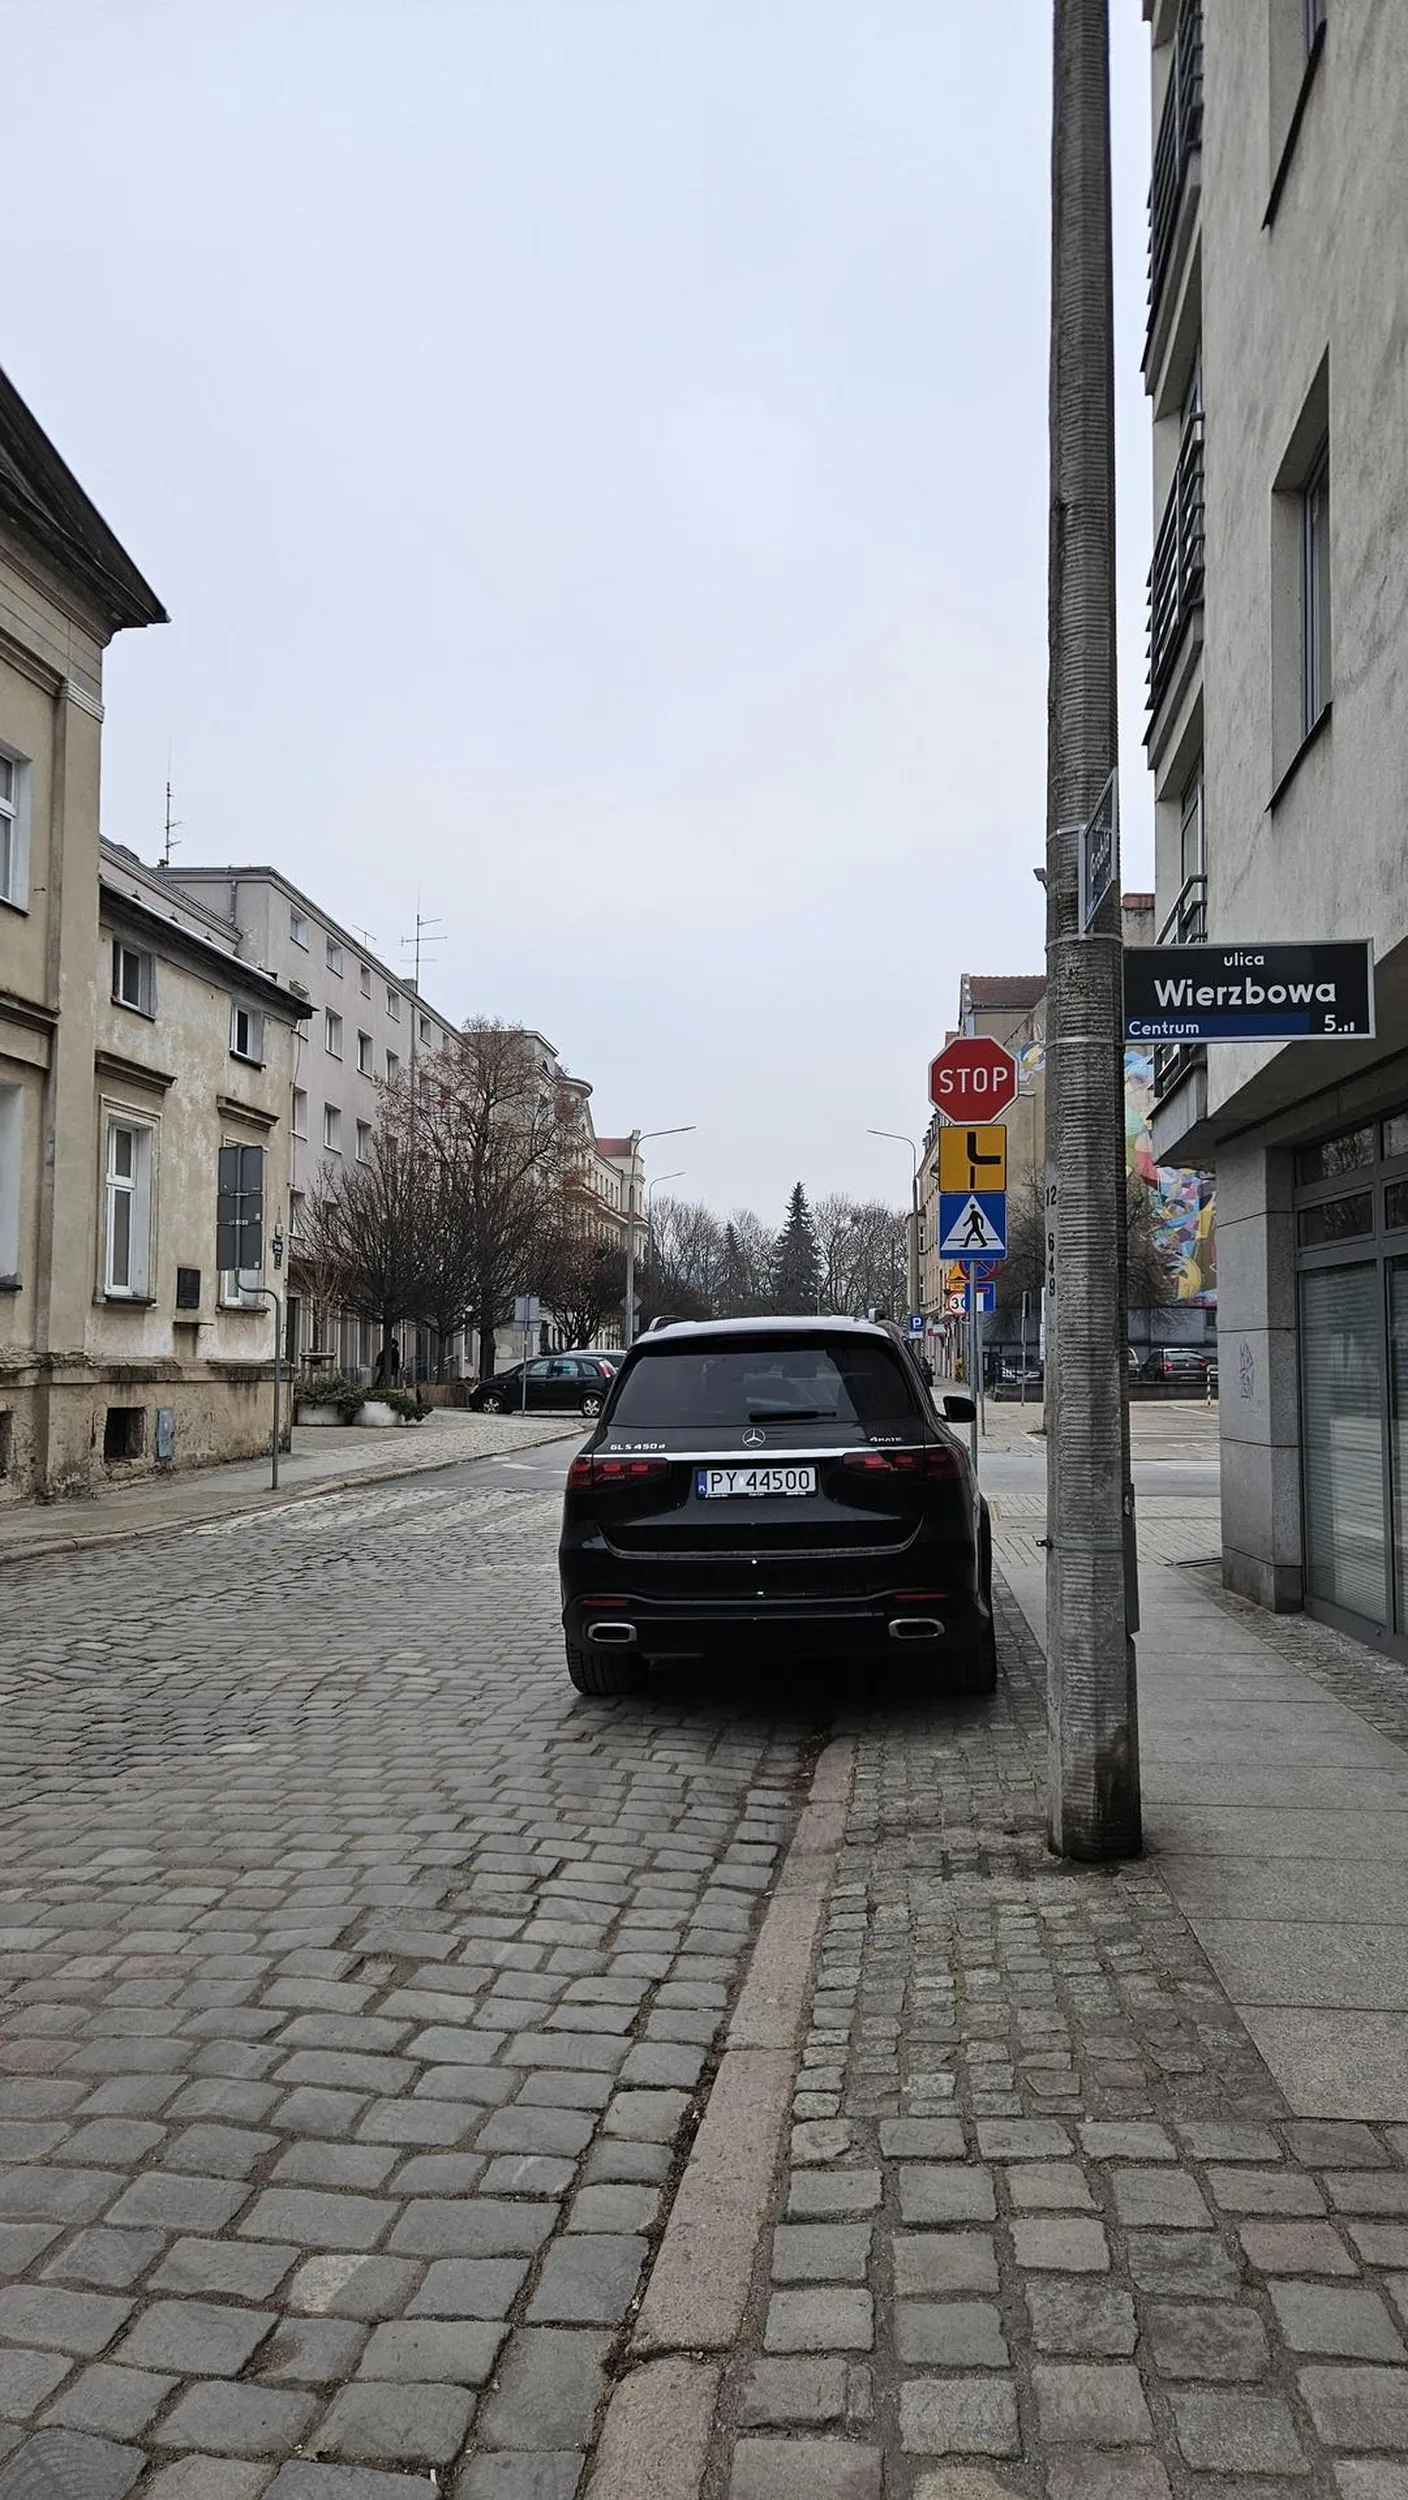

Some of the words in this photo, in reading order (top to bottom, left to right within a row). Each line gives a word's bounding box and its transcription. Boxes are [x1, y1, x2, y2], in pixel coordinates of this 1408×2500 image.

[1223, 952, 1265, 967] ulica
[1154, 976, 1337, 1008] Wierzbowa
[1128, 1020, 1200, 1037] Centrum
[939, 1066, 1008, 1095] STOP
[1046, 1185, 1057, 1206] 12
[610, 1443, 632, 1451] GLS
[711, 1471, 737, 1492] PY
[746, 1470, 810, 1491] 44500
